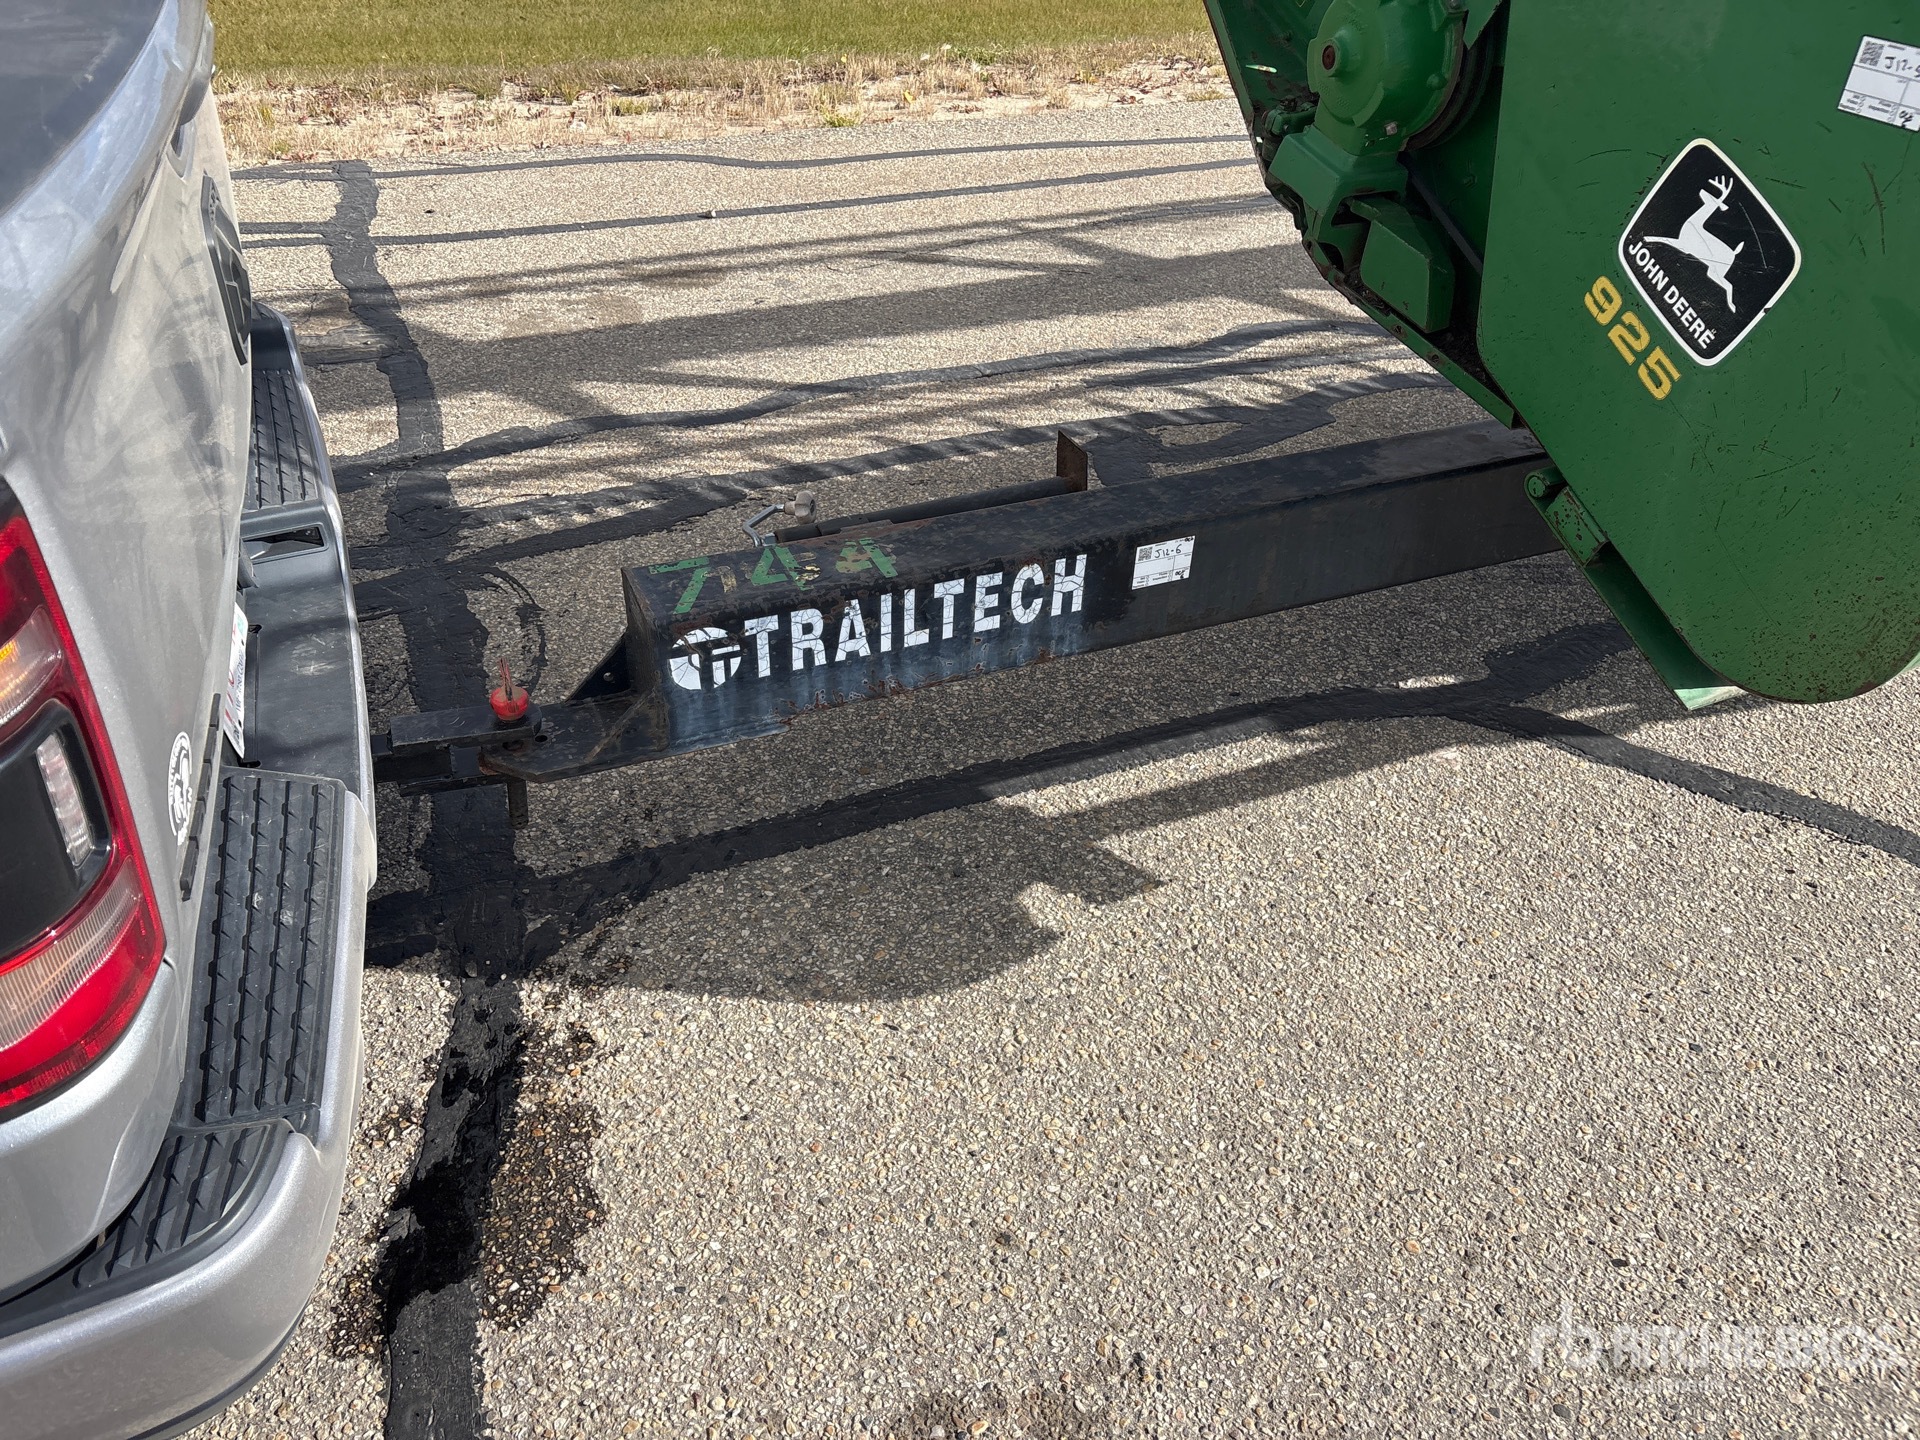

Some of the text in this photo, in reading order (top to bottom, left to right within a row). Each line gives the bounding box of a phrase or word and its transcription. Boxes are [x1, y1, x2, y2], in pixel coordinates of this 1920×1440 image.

[1584, 275, 1682, 400] 925
[1628, 241, 1715, 349] JOHN DEERE
[744, 554, 1087, 678] TRAILTECH
